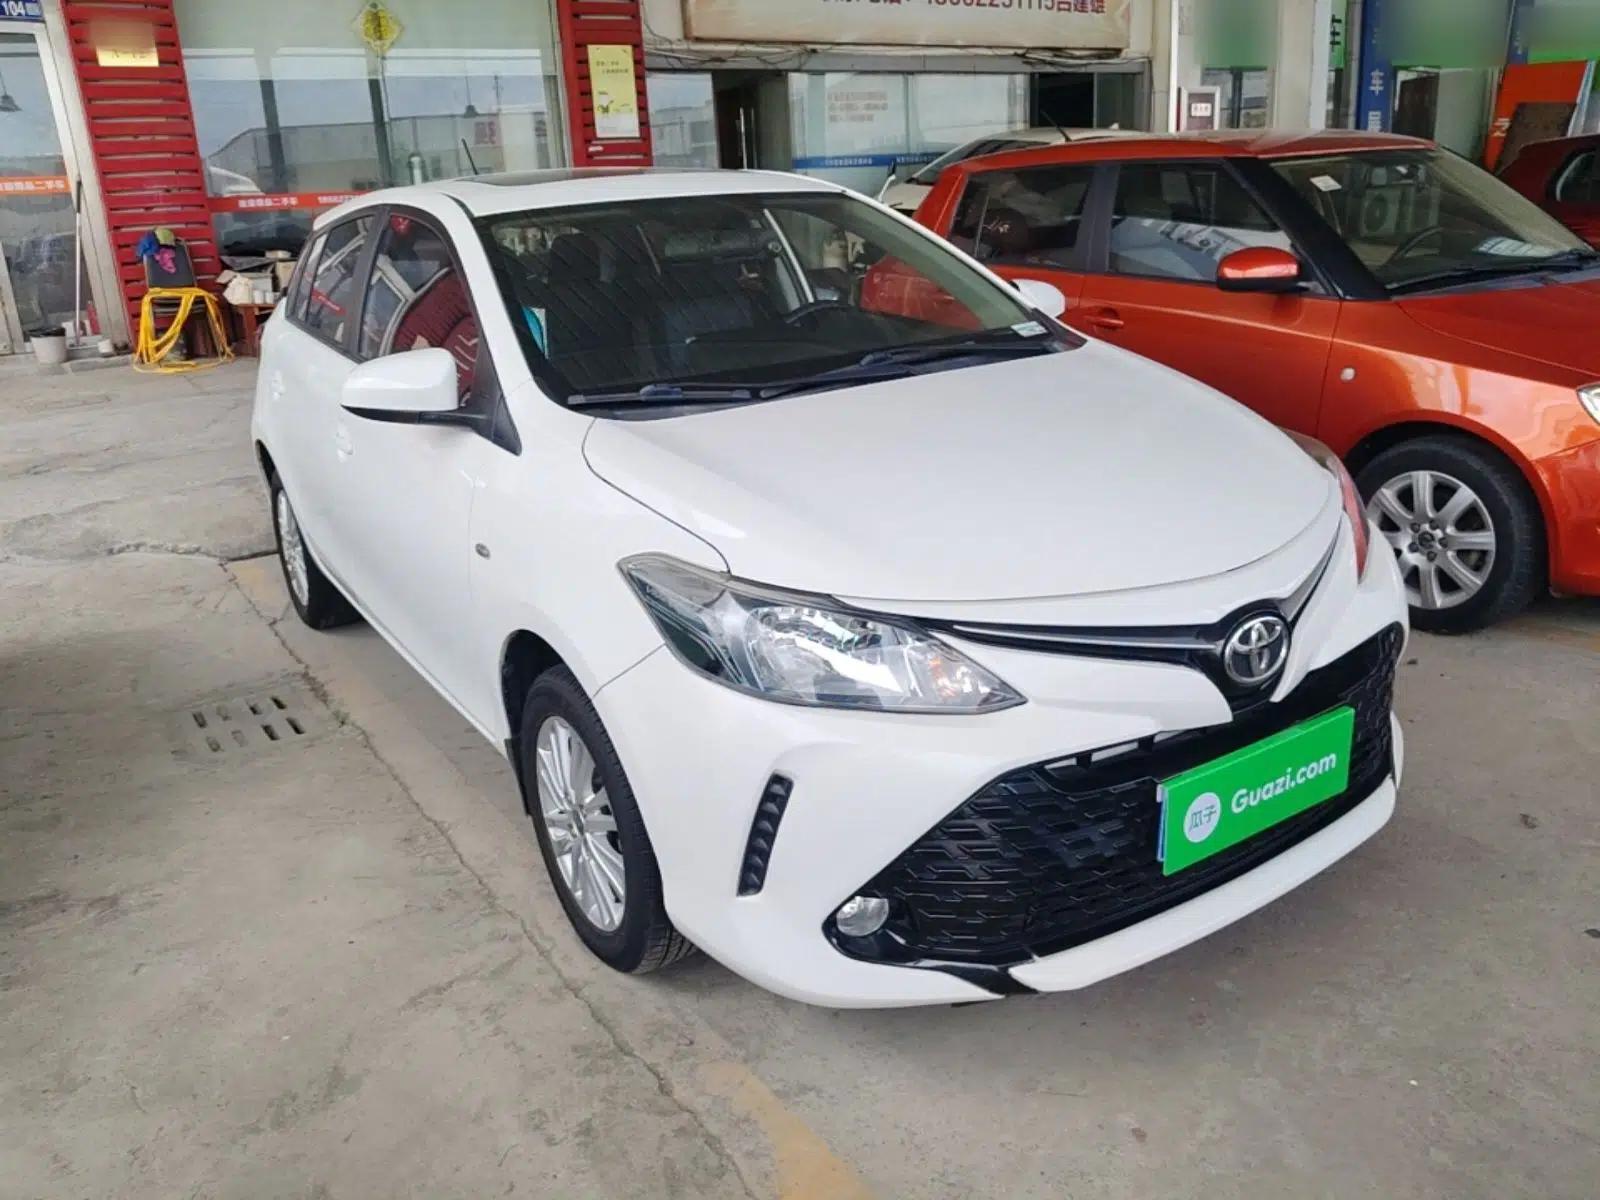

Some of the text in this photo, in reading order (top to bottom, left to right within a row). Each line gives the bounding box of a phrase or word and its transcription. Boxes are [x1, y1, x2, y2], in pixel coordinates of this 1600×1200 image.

[2, 0, 26, 16] 104
[1231, 753, 1336, 814] Guazi.com
[1189, 804, 1217, 832] 瓜子
